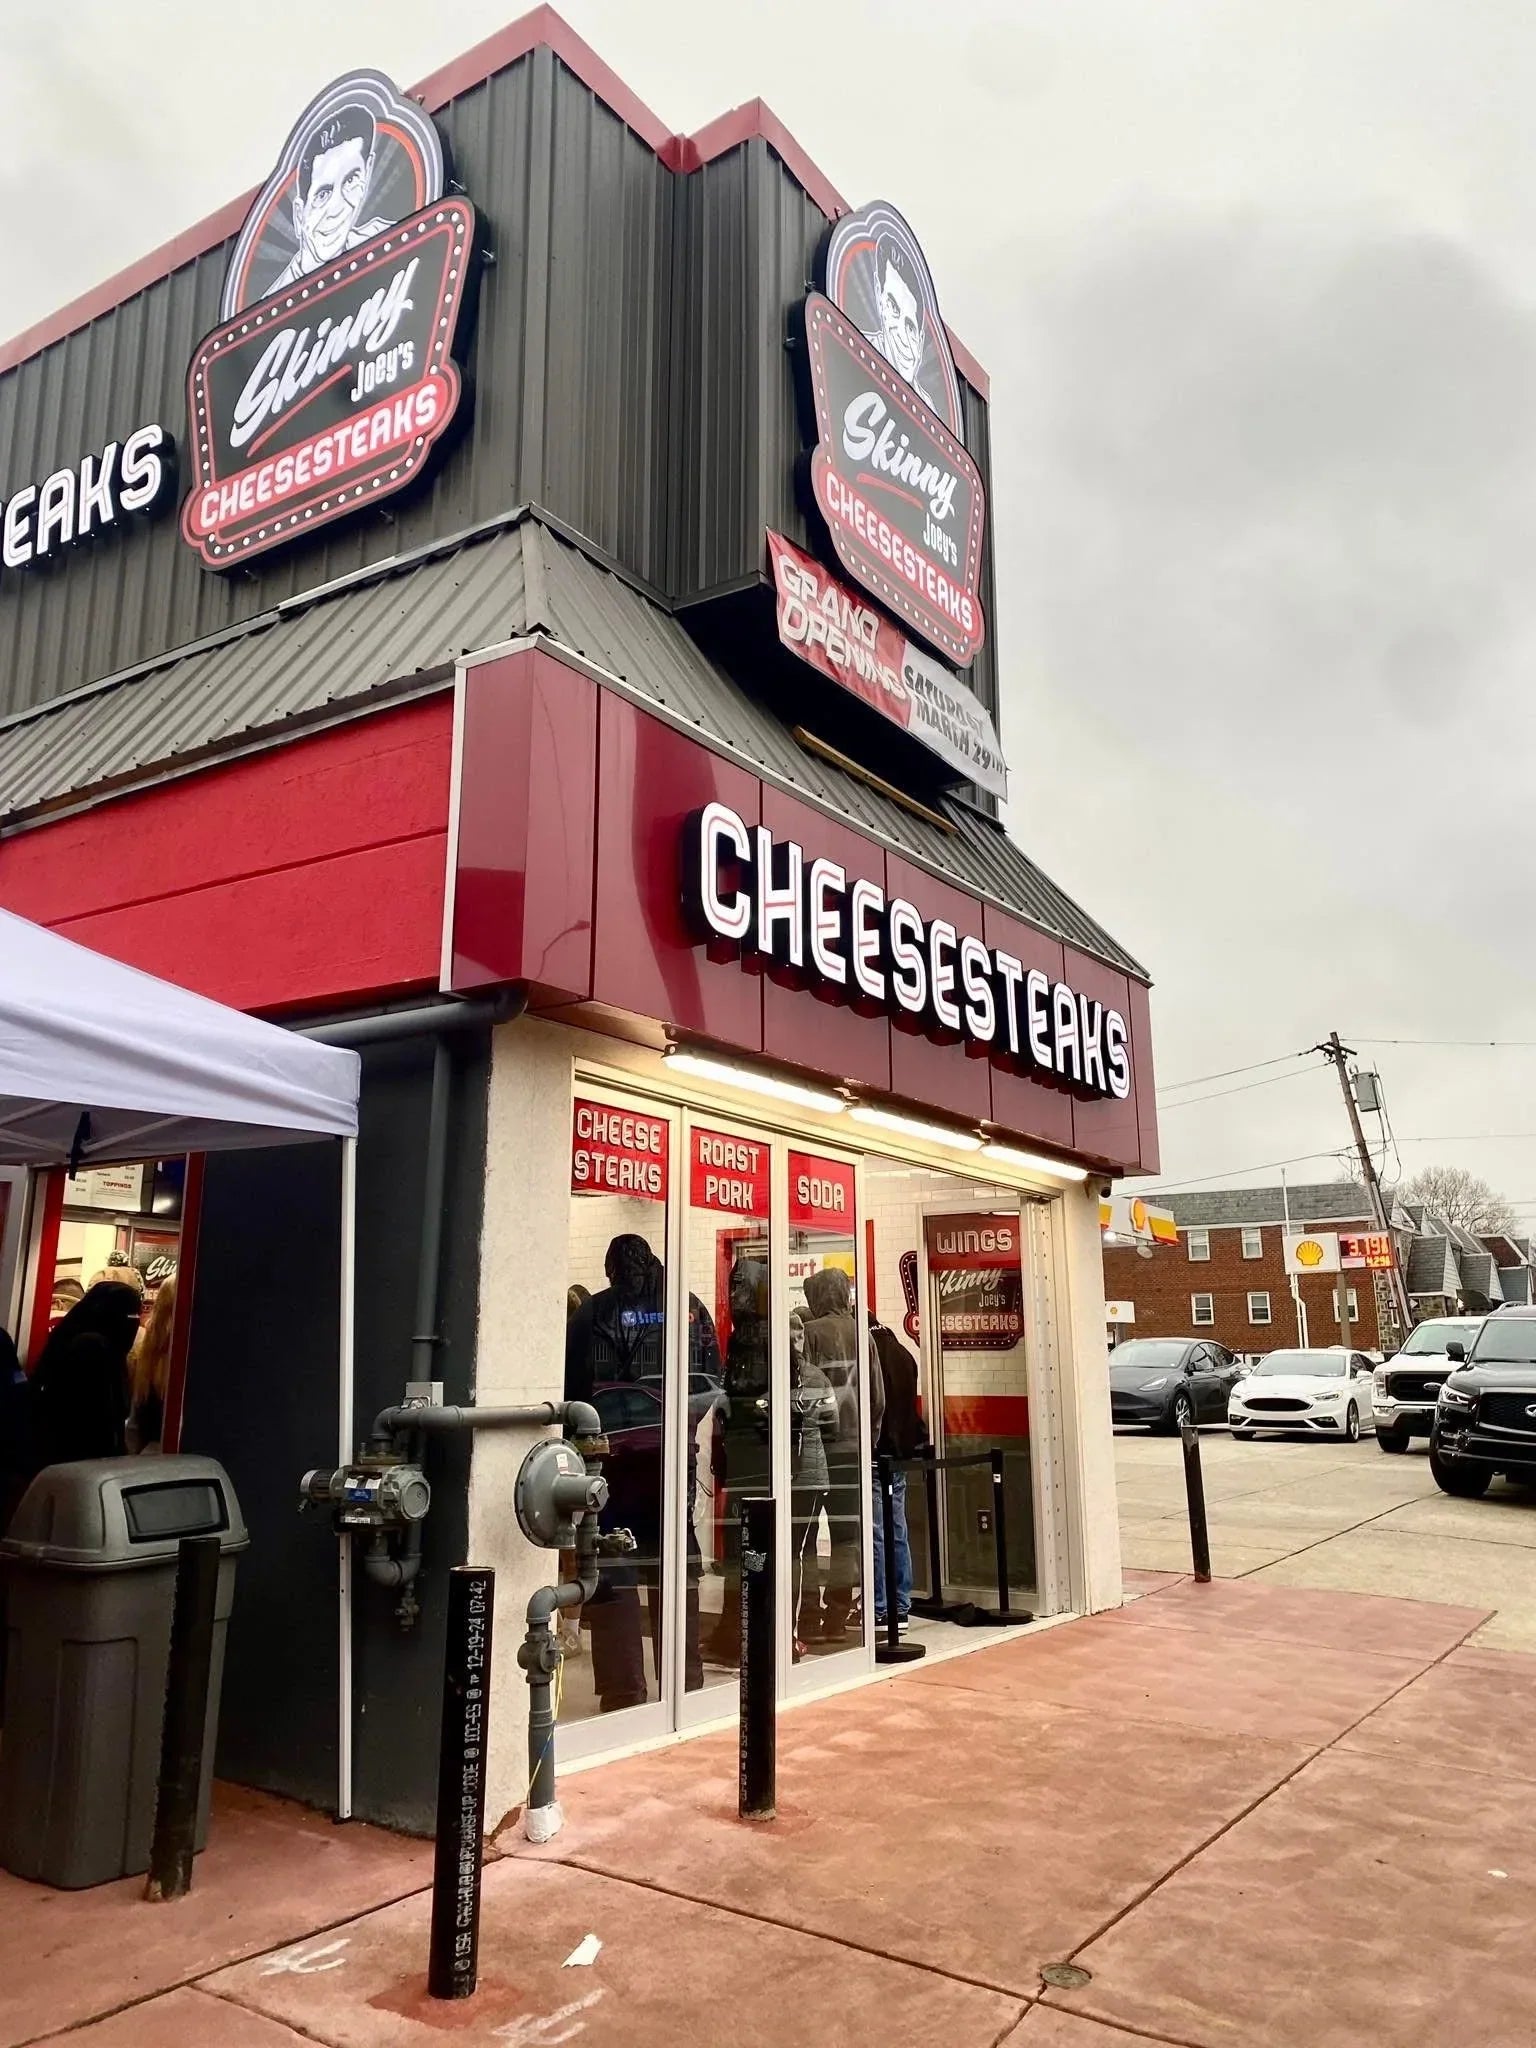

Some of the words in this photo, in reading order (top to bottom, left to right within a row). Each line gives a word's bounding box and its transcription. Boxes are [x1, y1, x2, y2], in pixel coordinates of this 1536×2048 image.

[229, 257, 420, 448] Skinny
[350, 340, 415, 402] Joey's
[201, 383, 437, 529] CHEESESTEAKS
[842, 391, 957, 520] Skinny
[0, 423, 163, 568] EAKS
[826, 471, 974, 632] CHEESESTEAKS
[923, 512, 958, 568] Joey's
[778, 554, 880, 651] GRAND
[782, 595, 912, 700] OPENING
[914, 695, 970, 756] MARCH
[700, 801, 1130, 1100] CHEESESTEAKS
[577, 1107, 661, 1154] CHEESE
[700, 1136, 759, 1175] ROAST
[574, 1149, 661, 1194] STEAKS
[705, 1174, 754, 1211] PORK
[797, 1175, 845, 1212] SODA
[936, 1228, 1013, 1254] WINGS
[940, 1269, 1003, 1296] kinny
[978, 1293, 1006, 1308] Joey's
[468, 1579, 487, 1614] 07:42
[466, 1616, 485, 1672] 12-19-24
[463, 1703, 482, 1744] ICC-ES
